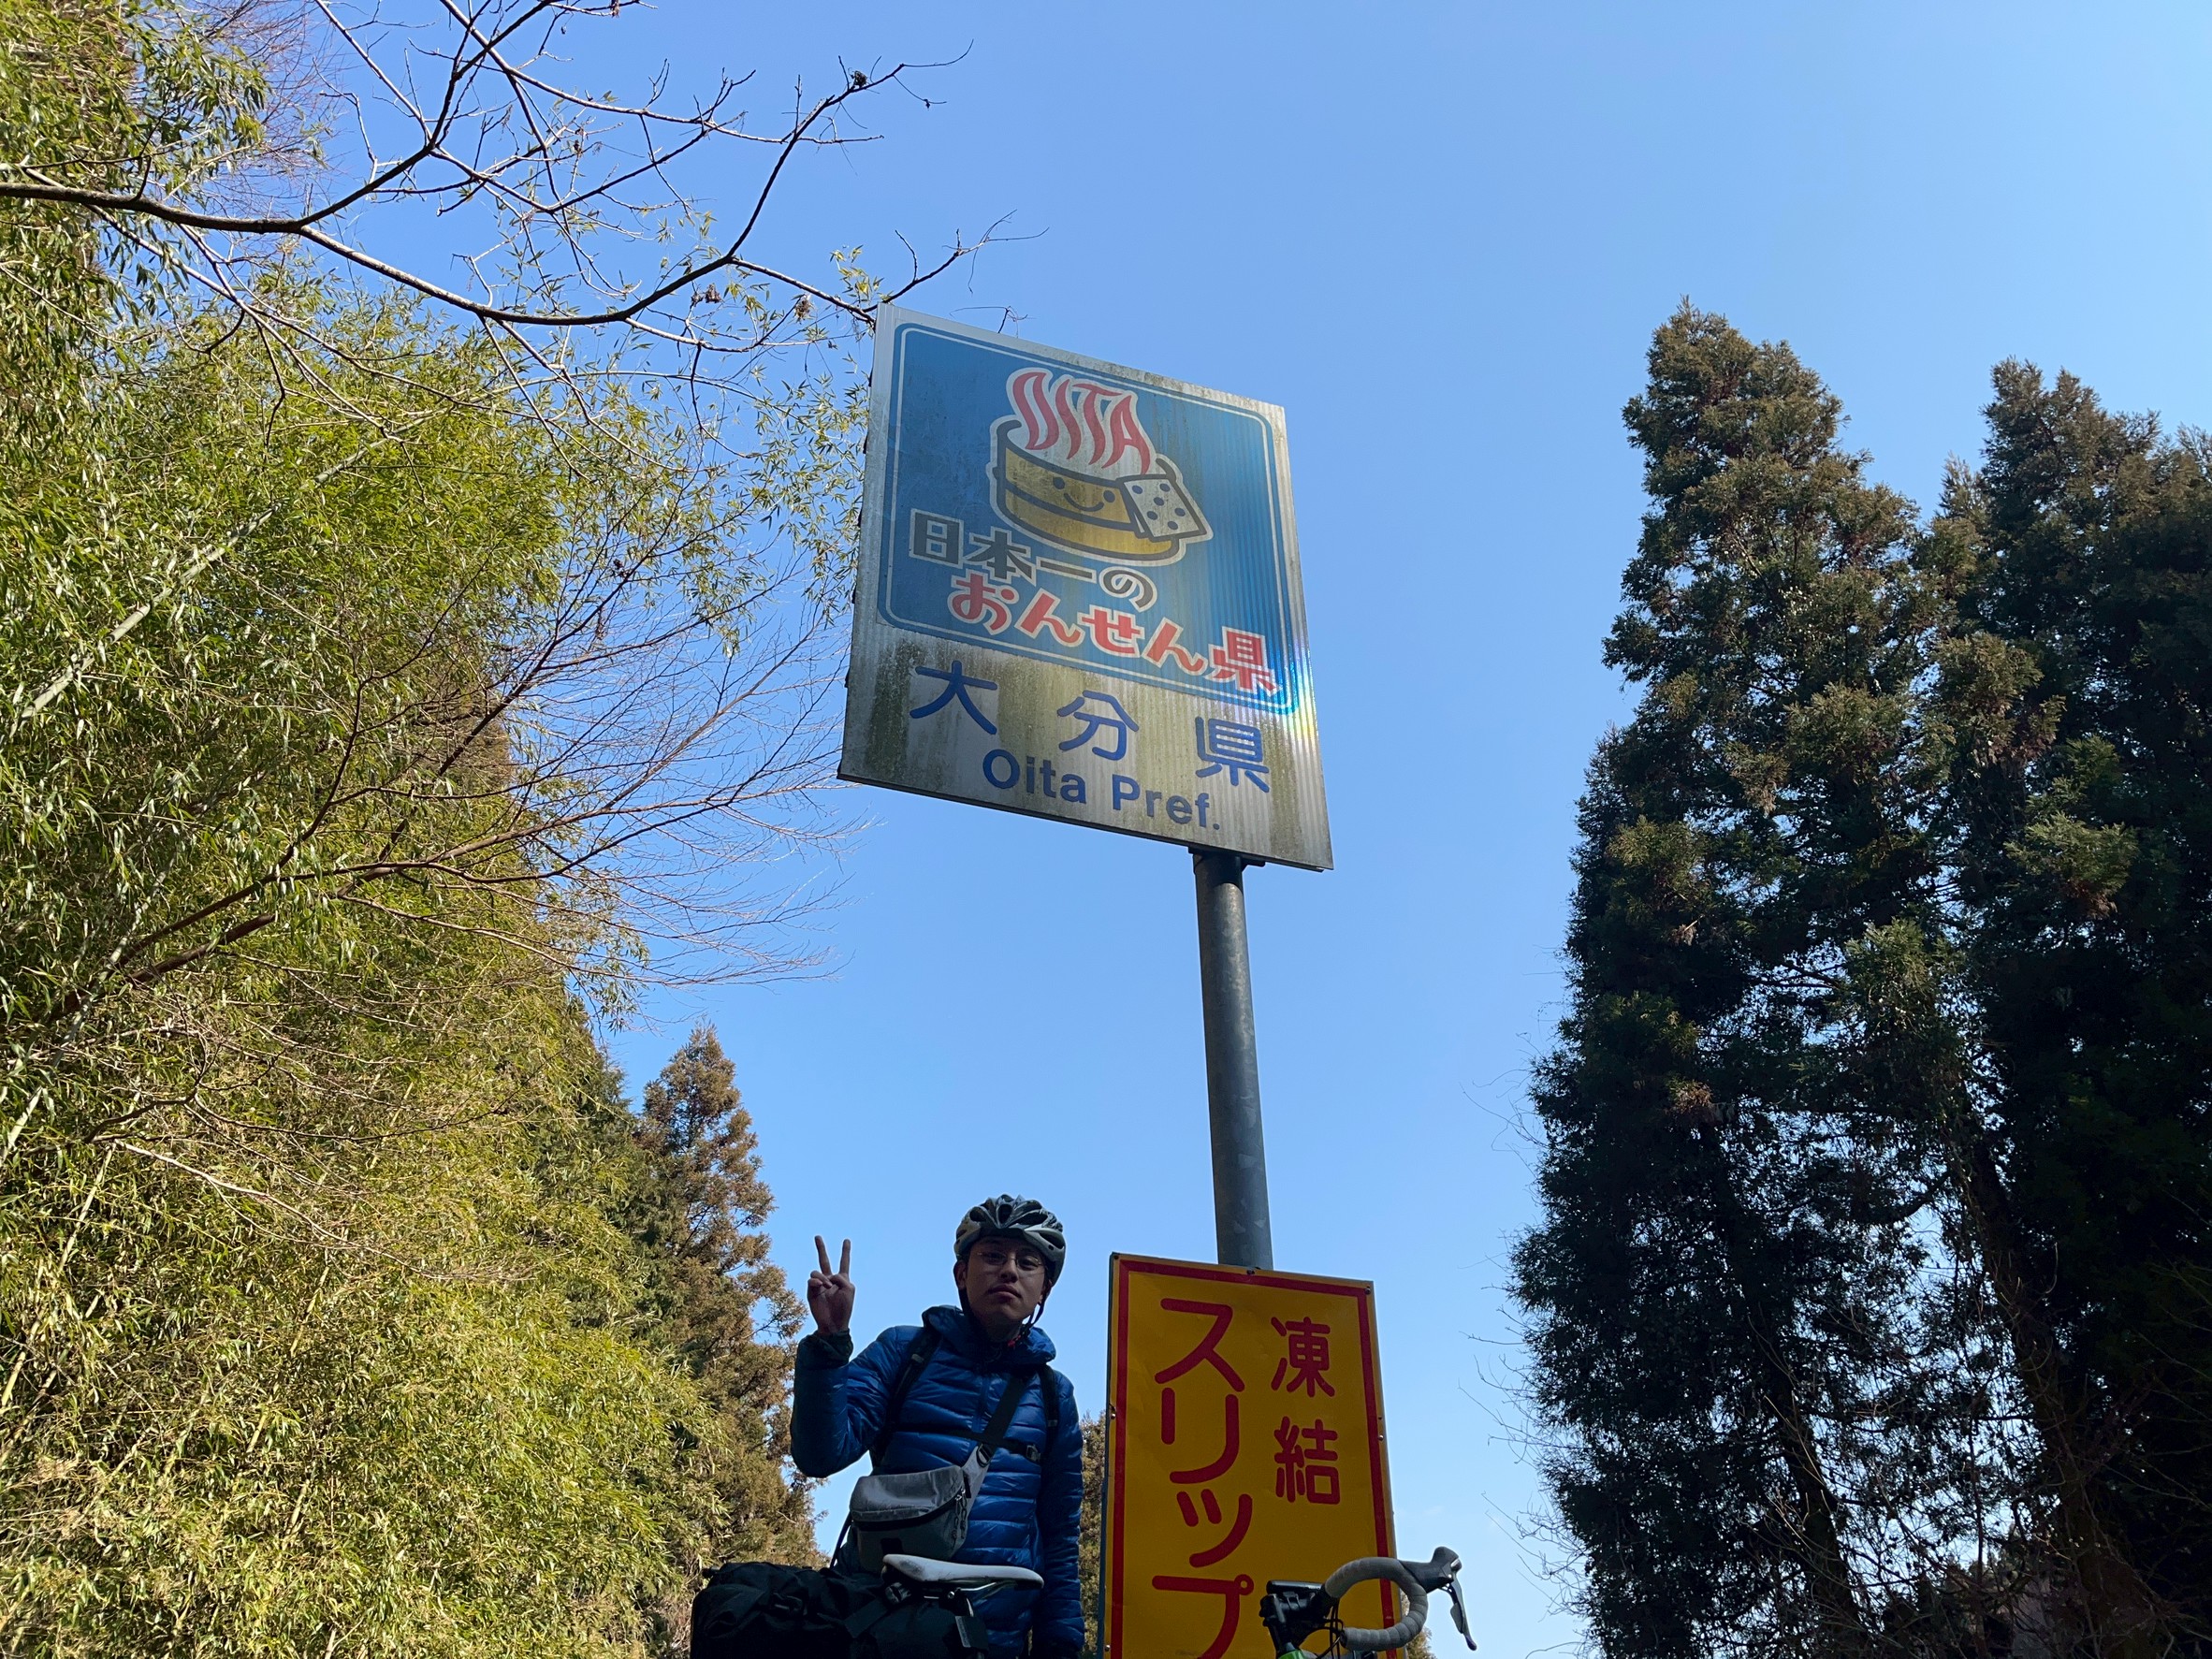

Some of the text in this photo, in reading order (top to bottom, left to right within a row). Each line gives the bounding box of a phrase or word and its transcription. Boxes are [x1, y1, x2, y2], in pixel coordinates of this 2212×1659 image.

[1012, 371, 1150, 474] OITA
[914, 516, 1155, 607] 日本一の
[951, 574, 1274, 691] おんせん県
[910, 661, 1270, 793] 大分県
[982, 748, 1220, 830] Oita Pref.
[1270, 1317, 1341, 1505] 凍結
[1152, 1298, 1254, 1659] スリップ
